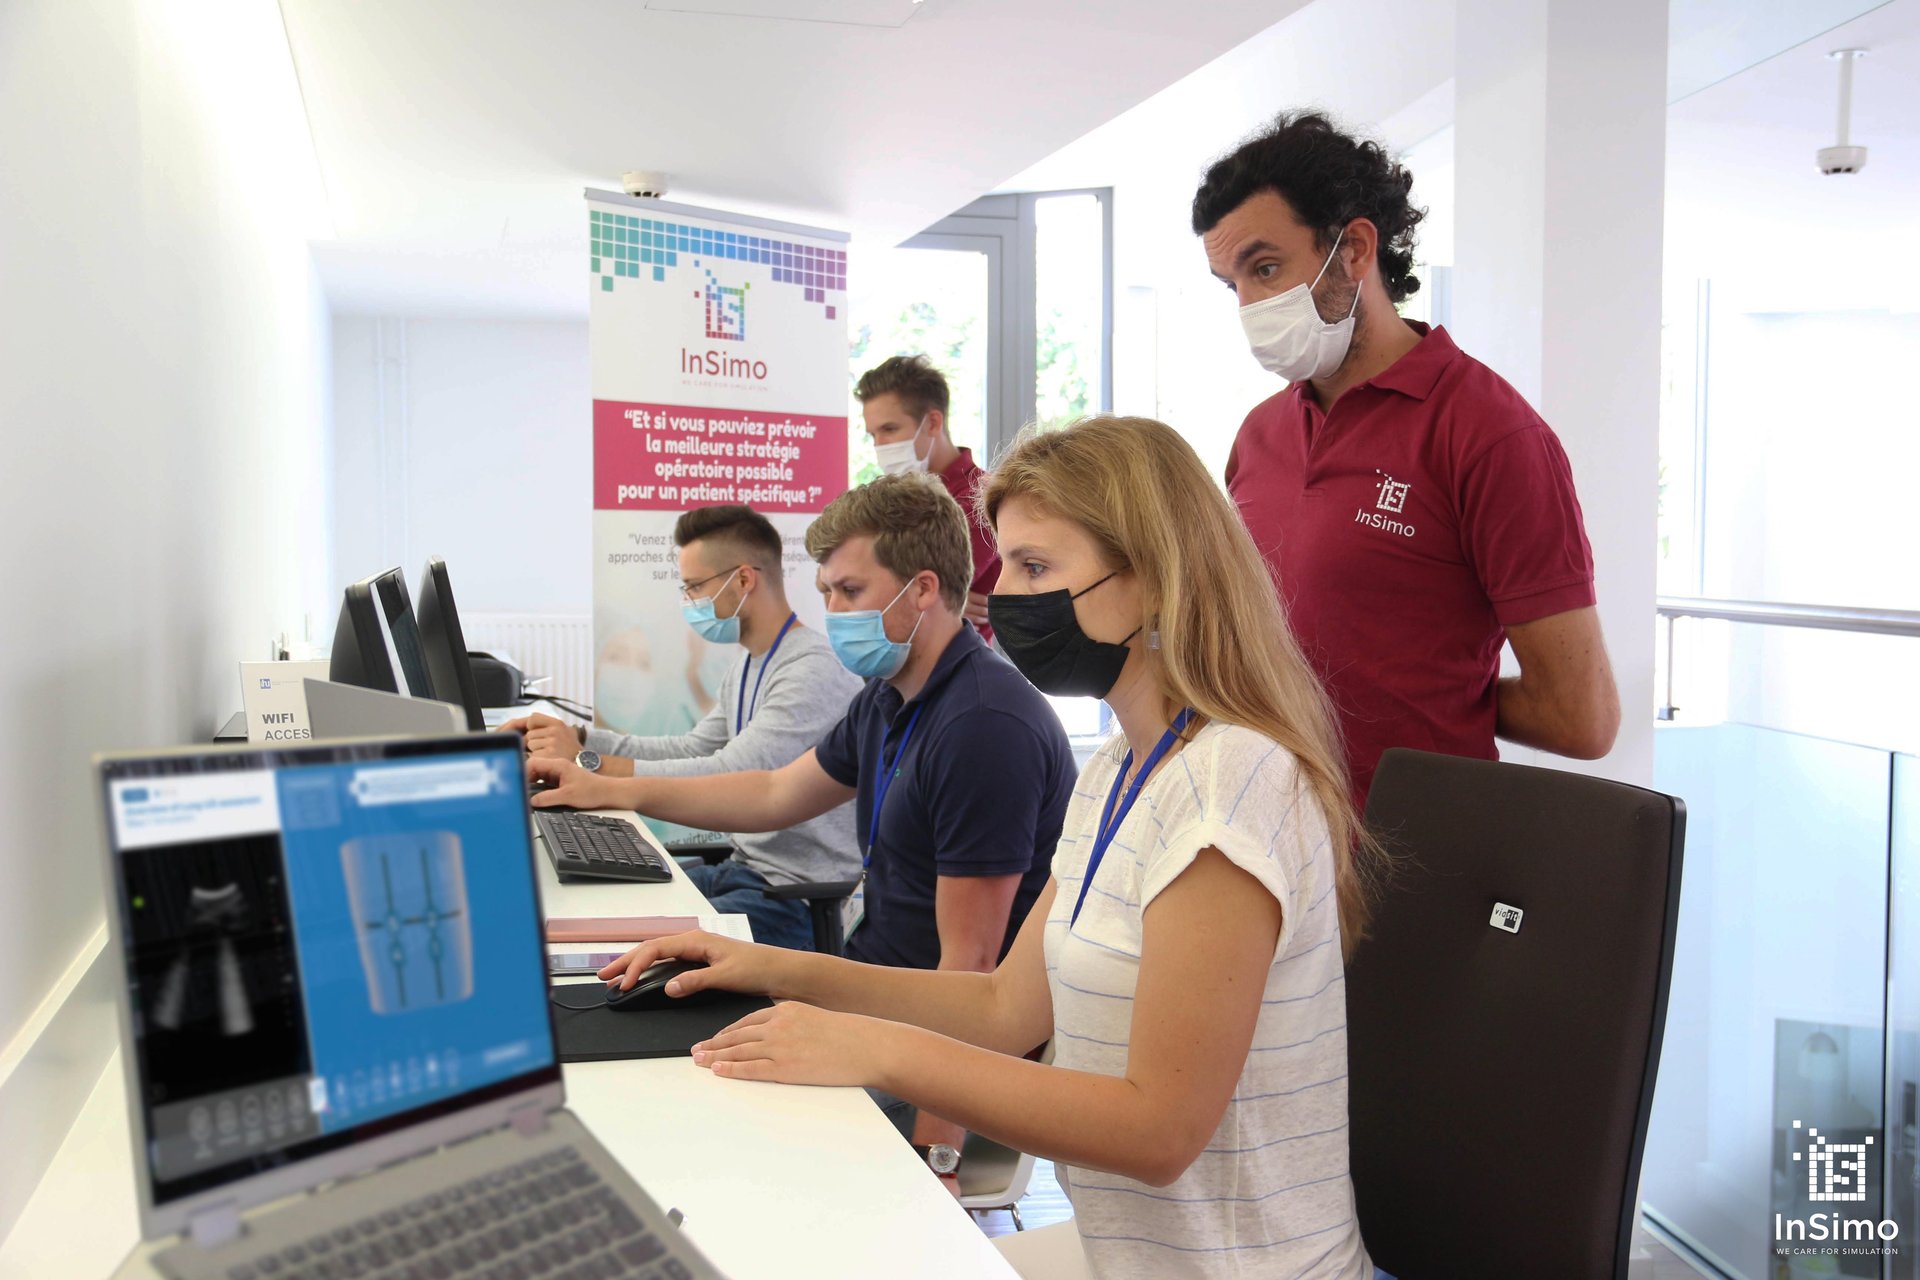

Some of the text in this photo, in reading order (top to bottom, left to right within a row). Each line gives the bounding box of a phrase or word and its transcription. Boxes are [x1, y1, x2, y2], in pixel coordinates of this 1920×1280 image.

[681, 347, 768, 380] InSimo
[654, 412, 667, 431] si
[670, 416, 705, 433] vous
[709, 416, 765, 437] pouviez
[768, 419, 817, 439] prévoir
[646, 434, 800, 464] la meilleure stratégie
[655, 458, 793, 483] opératoire possible
[618, 484, 655, 504] pour
[659, 486, 678, 500] un
[681, 483, 735, 505] patient
[737, 484, 806, 507] spécifique
[1354, 508, 1416, 537] InSimo
[608, 550, 664, 565] approches
[652, 570, 668, 580] sur
[262, 712, 295, 725] WIFI
